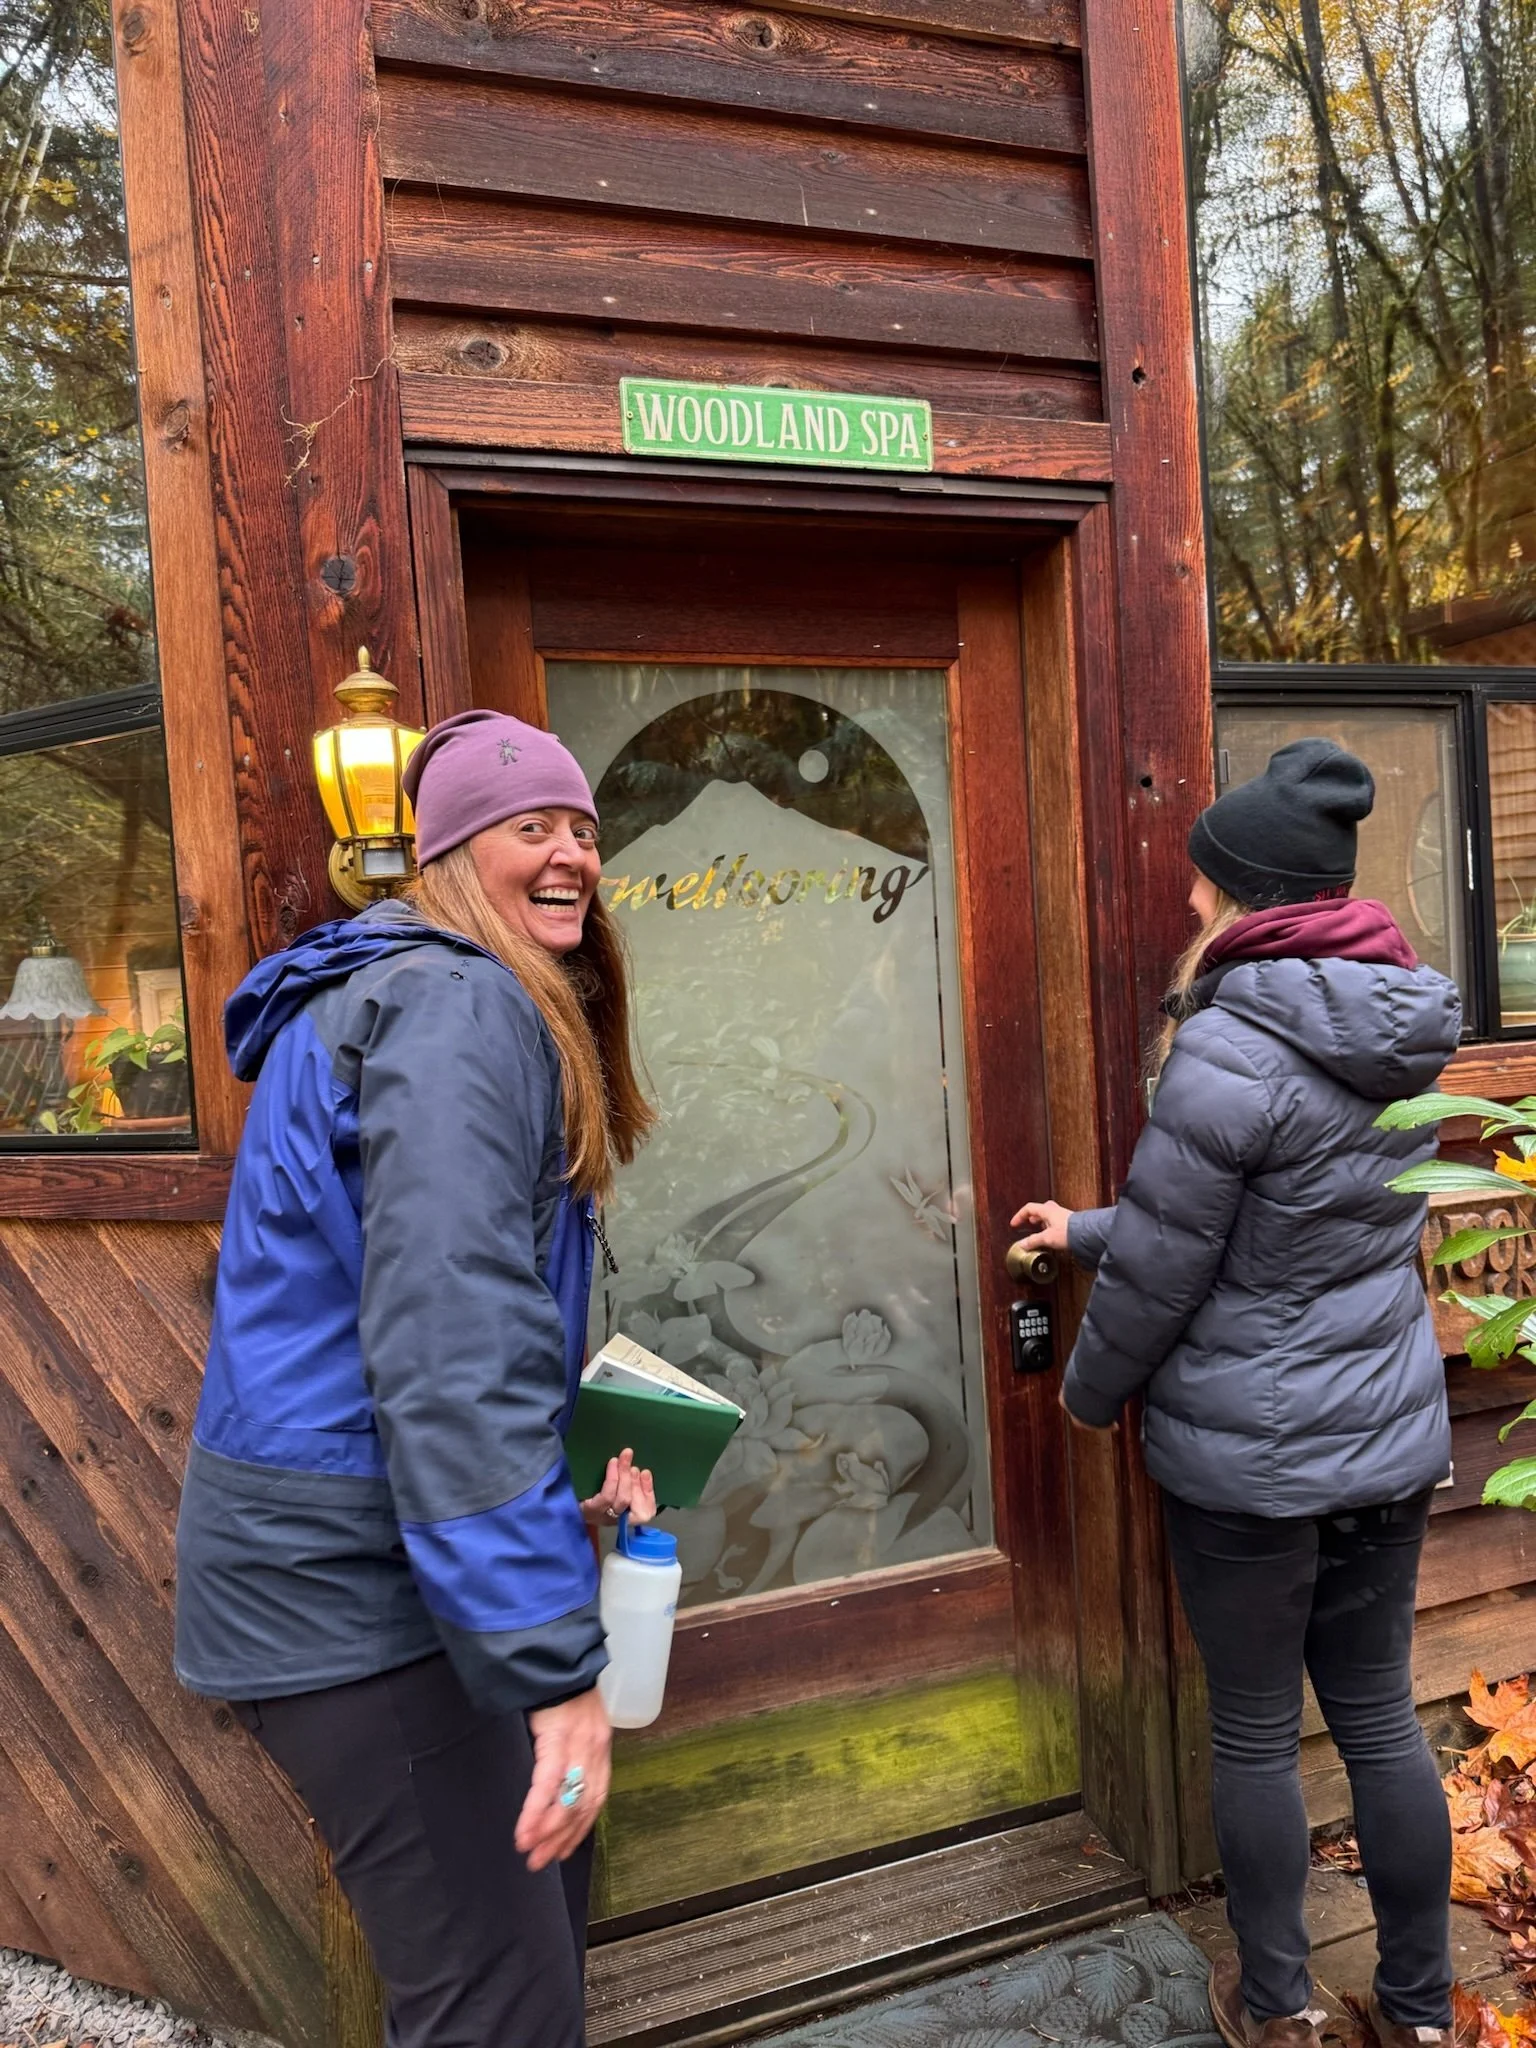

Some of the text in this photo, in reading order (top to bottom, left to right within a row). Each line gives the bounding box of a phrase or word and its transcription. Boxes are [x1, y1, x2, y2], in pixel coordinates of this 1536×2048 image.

[634, 392, 921, 459] WOODLAND SPA
[600, 852, 930, 924] wellspring
